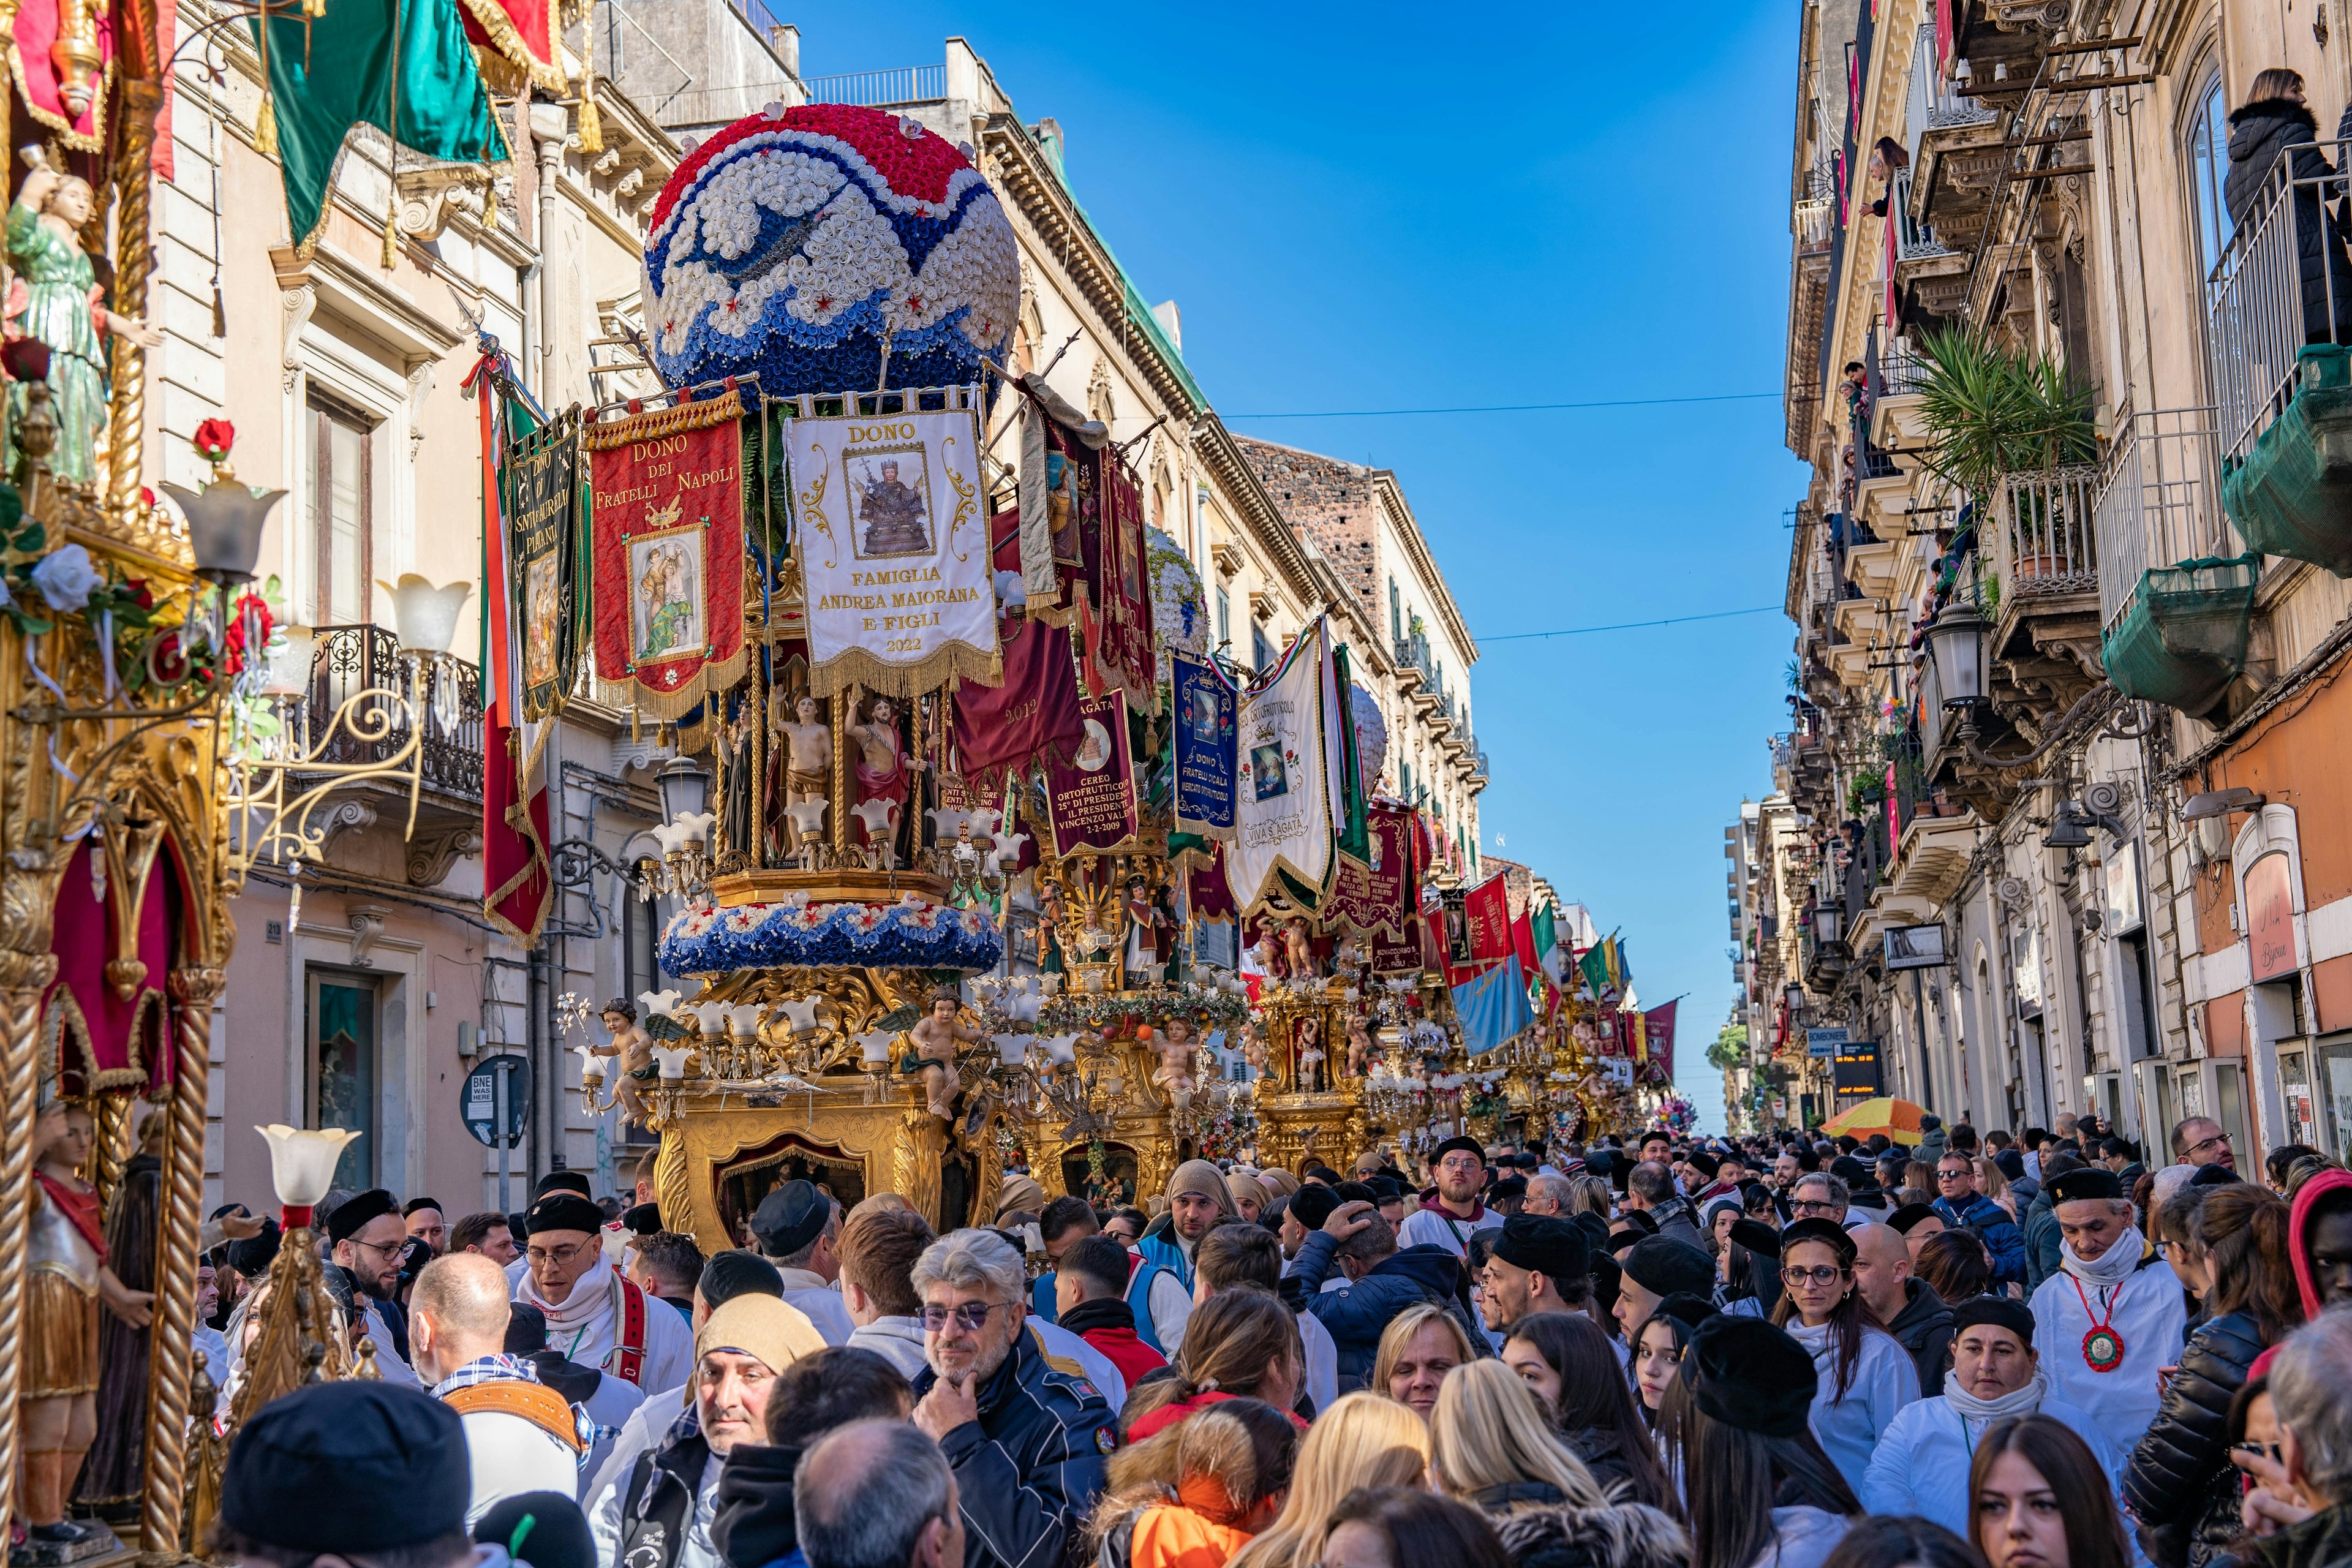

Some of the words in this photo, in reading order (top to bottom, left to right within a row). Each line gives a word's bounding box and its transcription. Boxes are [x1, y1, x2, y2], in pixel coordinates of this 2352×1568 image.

[848, 422, 915, 443] DONO
[633, 434, 687, 462] DONO
[648, 461, 672, 479] DEI
[536, 478, 543, 499] DI
[596, 484, 658, 510] FRATELLI
[677, 467, 734, 491] NAPOLI
[851, 567, 942, 586] FAMIGLIA
[818, 594, 888, 610] ANDREA
[891, 587, 980, 607] MAIORANA
[862, 617, 877, 631] E
[883, 612, 941, 631] FIGLI
[886, 637, 921, 652] 2022
[1005, 698, 1037, 725] 2012
[1080, 701, 1114, 715] AGATA
[1250, 700, 1295, 723] ORTOFRUTTICOLO
[1196, 753, 1216, 767] DONO
[1080, 774, 1110, 786] CEREO
[1182, 767, 1208, 781] FRATELLI
[1208, 774, 1228, 787] CICALA
[1182, 782, 1201, 794] MERCATO
[1072, 798, 1082, 808] DI
[1084, 790, 1130, 805] PRESIDENZA
[1068, 810, 1077, 819] IL
[1078, 799, 1128, 816] PRESIDENTE
[1058, 814, 1105, 830] VINCENZO
[1086, 821, 1120, 834] 2-2-2009
[1248, 828, 1267, 842] VIVA
[1268, 826, 1275, 837] S.
[1276, 819, 1303, 835] AGATA
[268, 923, 280, 935] 213
[1809, 1031, 1847, 1041] BOMBONIERE
[473, 1077, 491, 1088] BNE
